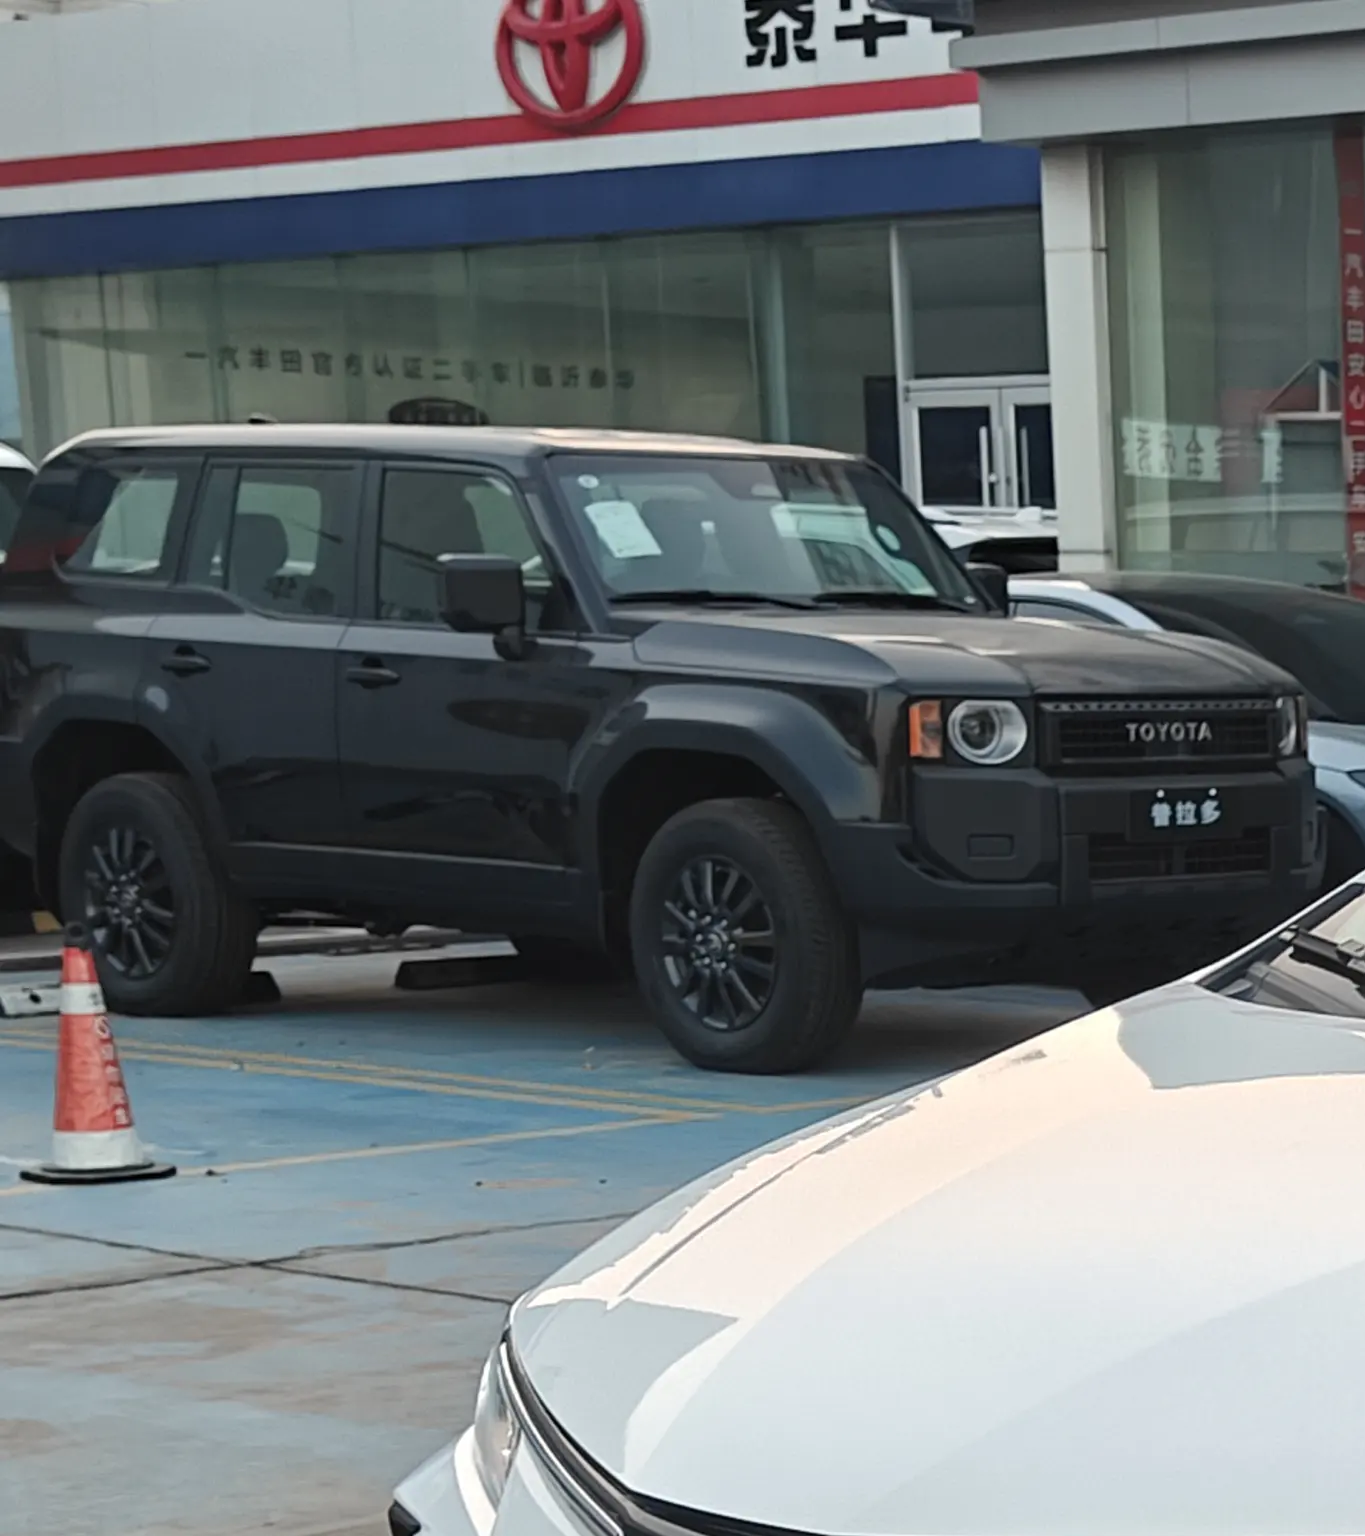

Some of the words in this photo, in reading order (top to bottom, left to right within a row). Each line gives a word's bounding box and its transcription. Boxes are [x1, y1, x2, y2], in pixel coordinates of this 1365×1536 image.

[1126, 721, 1213, 743] TOYOTA
[1150, 799, 1221, 828] 普拉多
